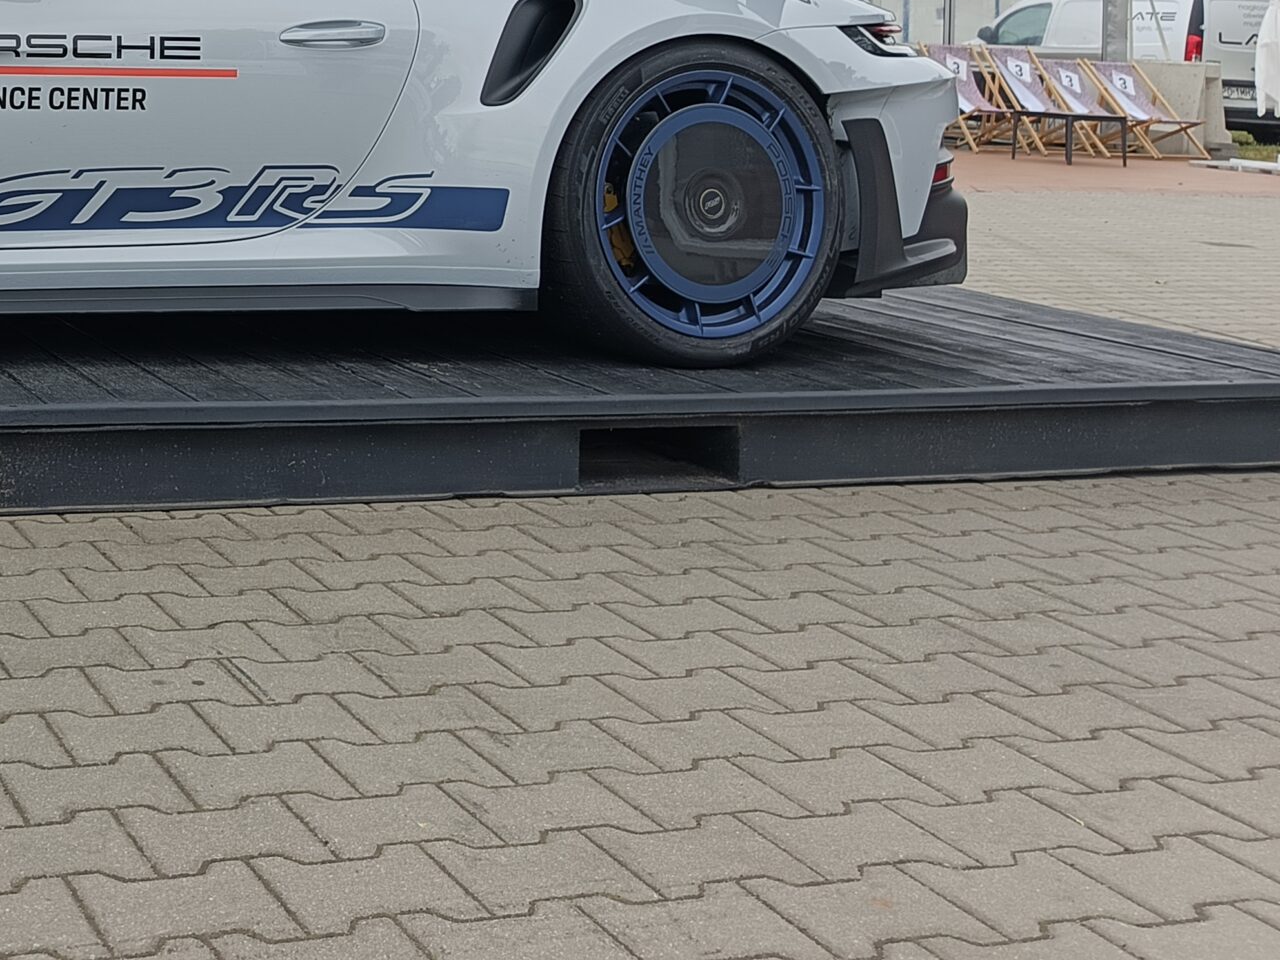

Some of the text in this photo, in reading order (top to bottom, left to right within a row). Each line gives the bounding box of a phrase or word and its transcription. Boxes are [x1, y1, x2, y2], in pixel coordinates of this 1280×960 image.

[1219, 31, 1259, 46] LA
[952, 61, 960, 75] 3
[1015, 64, 1023, 77] 3
[1065, 75, 1073, 88] 3
[1118, 77, 1127, 90] 3
[48, 86, 147, 111] CENTER
[632, 145, 654, 236] MANTHEY
